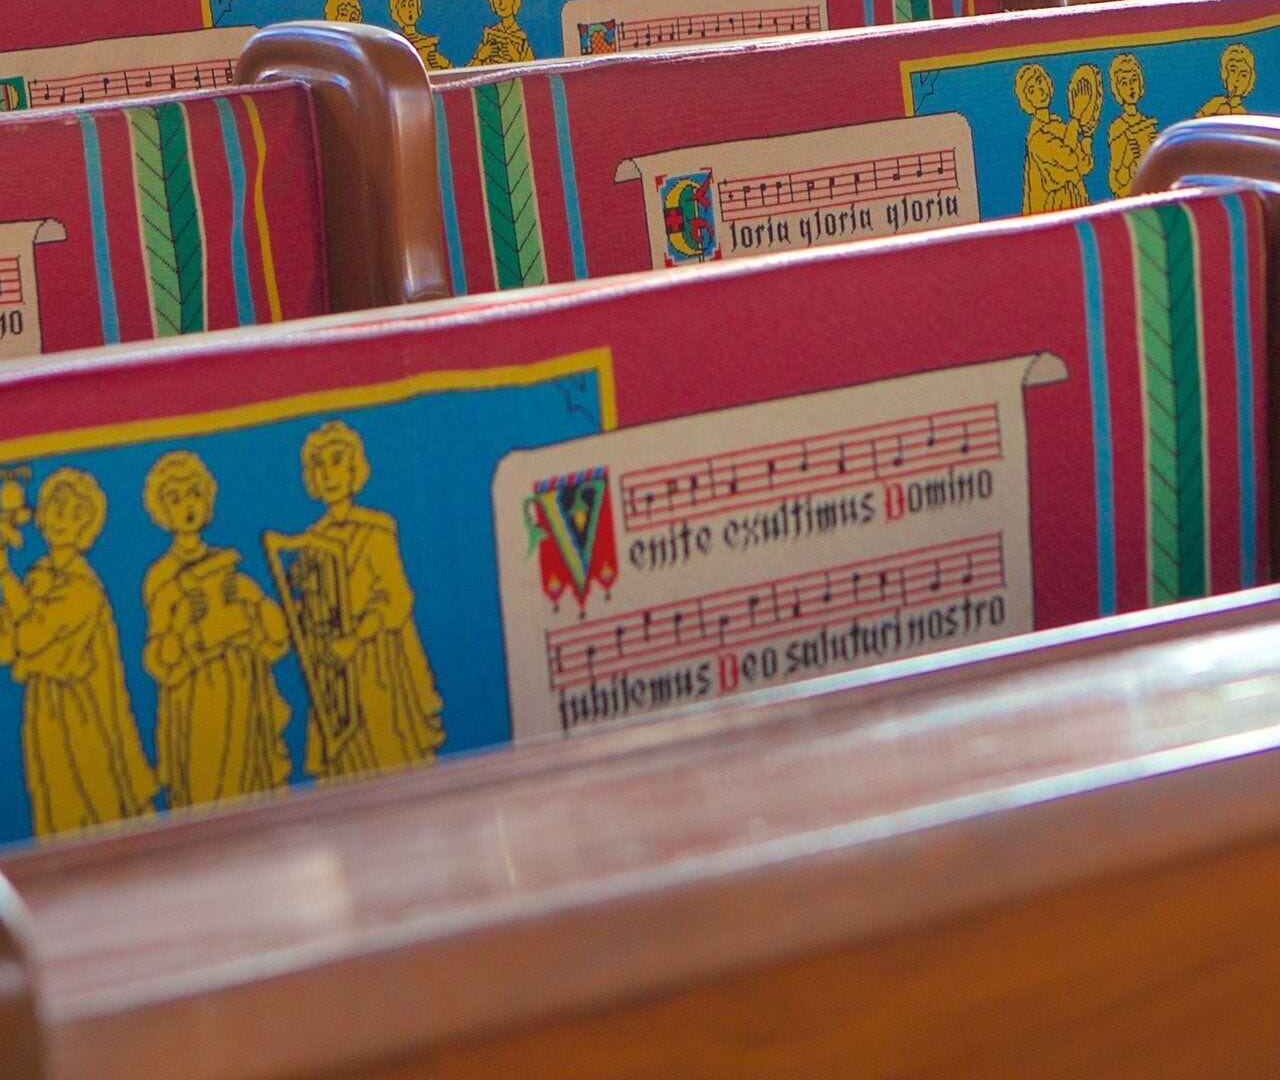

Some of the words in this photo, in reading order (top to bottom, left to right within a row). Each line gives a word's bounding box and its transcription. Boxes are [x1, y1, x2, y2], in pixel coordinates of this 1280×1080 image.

[800, 202, 874, 248] gloria
[886, 190, 960, 234] gloria
[881, 465, 993, 522] Domino
[719, 645, 779, 694] Deo
[903, 594, 1007, 647] nostro
